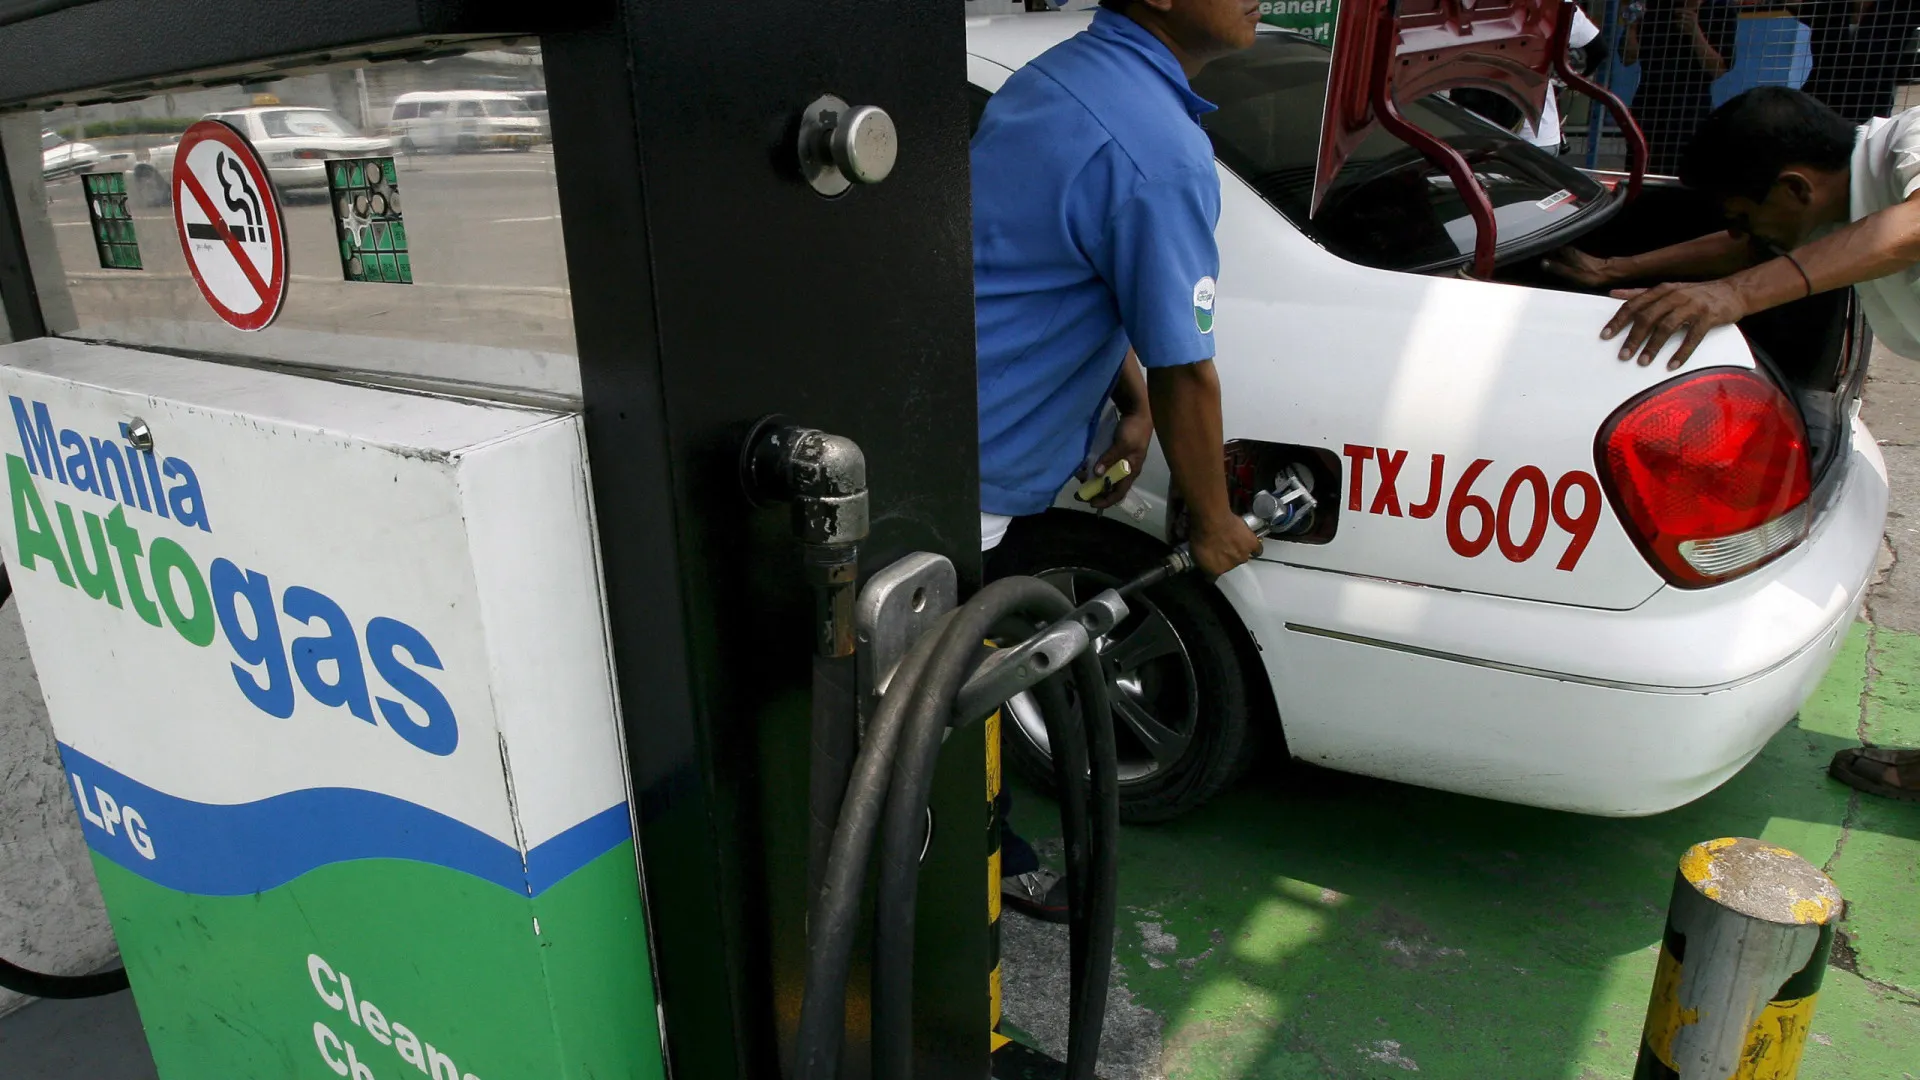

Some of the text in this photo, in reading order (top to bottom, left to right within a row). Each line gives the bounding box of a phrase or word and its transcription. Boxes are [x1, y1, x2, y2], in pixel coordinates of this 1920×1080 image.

[1290, 22, 1330, 40] er!
[8, 395, 212, 534] Manila
[1343, 443, 1602, 572] TXJ609
[5, 452, 459, 756] Autogas
[72, 772, 156, 860] LPG
[307, 953, 482, 1080] Clean
